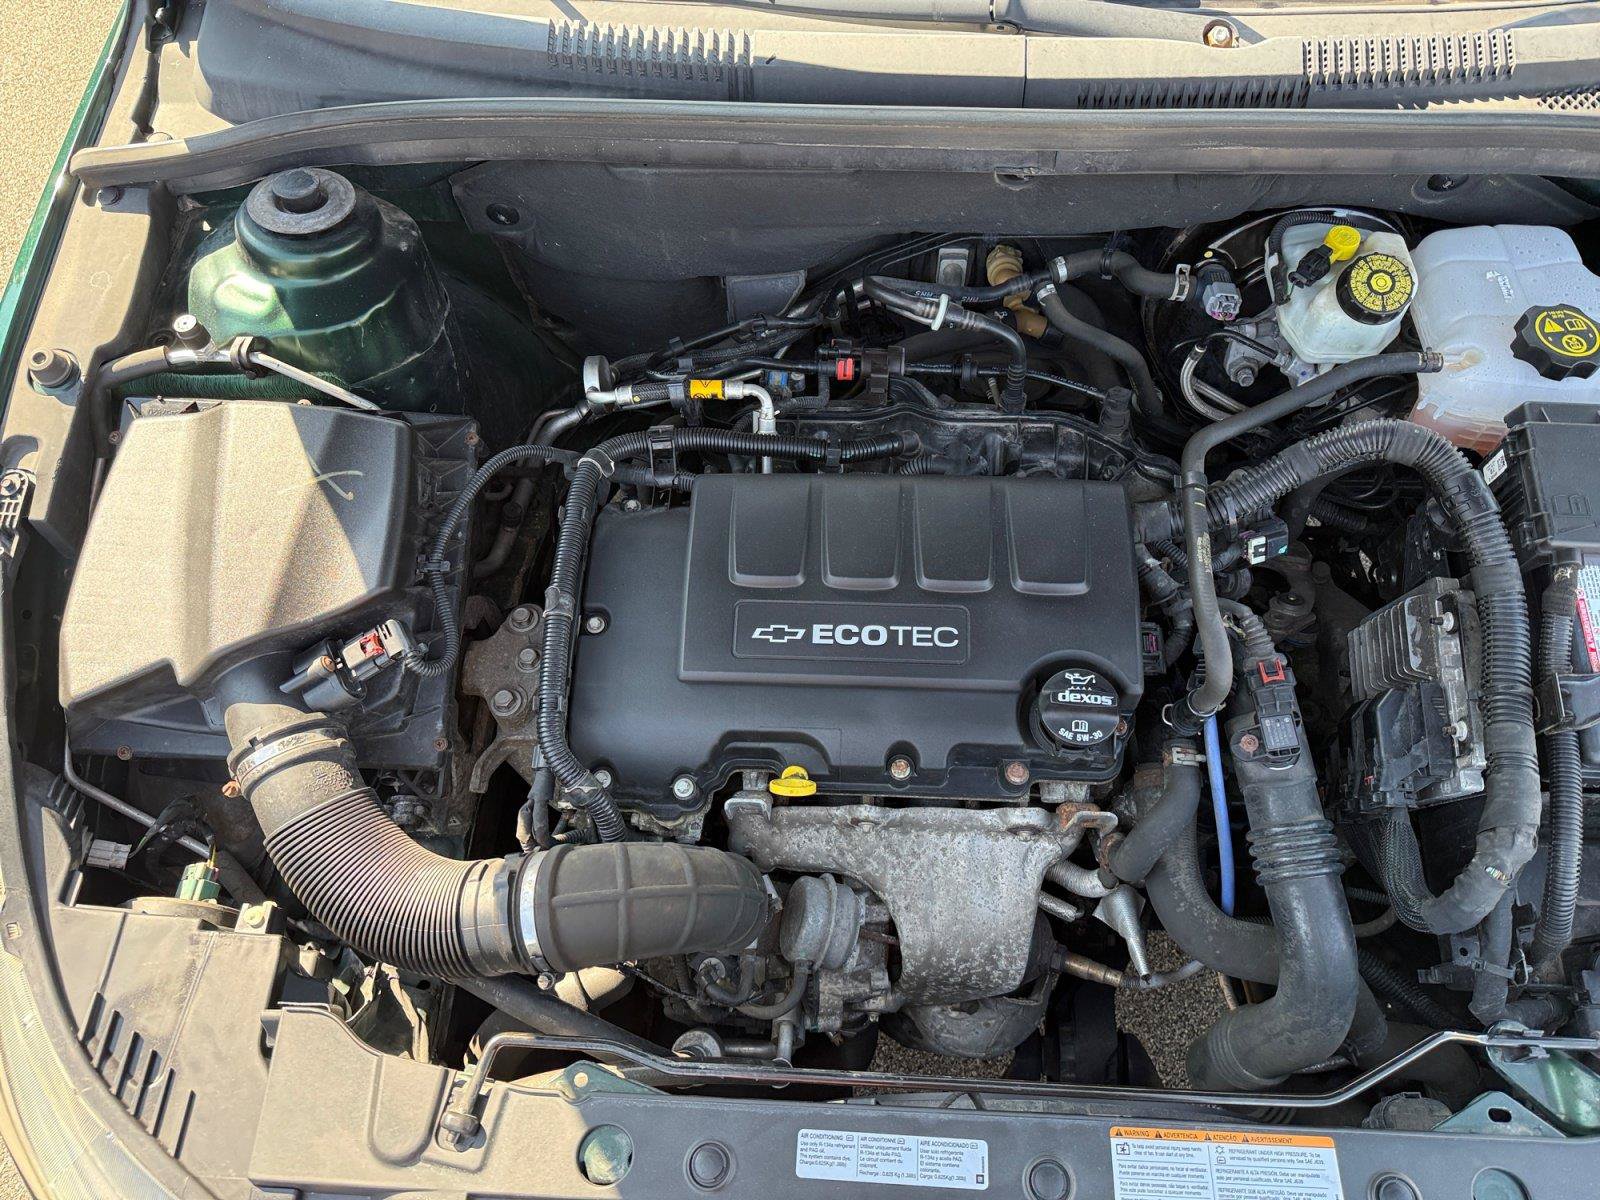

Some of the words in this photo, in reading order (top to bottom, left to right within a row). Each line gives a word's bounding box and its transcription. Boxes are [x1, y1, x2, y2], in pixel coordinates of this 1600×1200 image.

[812, 624, 958, 648] ECOTEC
[1058, 690, 1113, 705] dexos
[1059, 728, 1074, 740] SAE
[1076, 730, 1103, 741] 5W-30
[1251, 1136, 1292, 1144] AVERTISSEMENT
